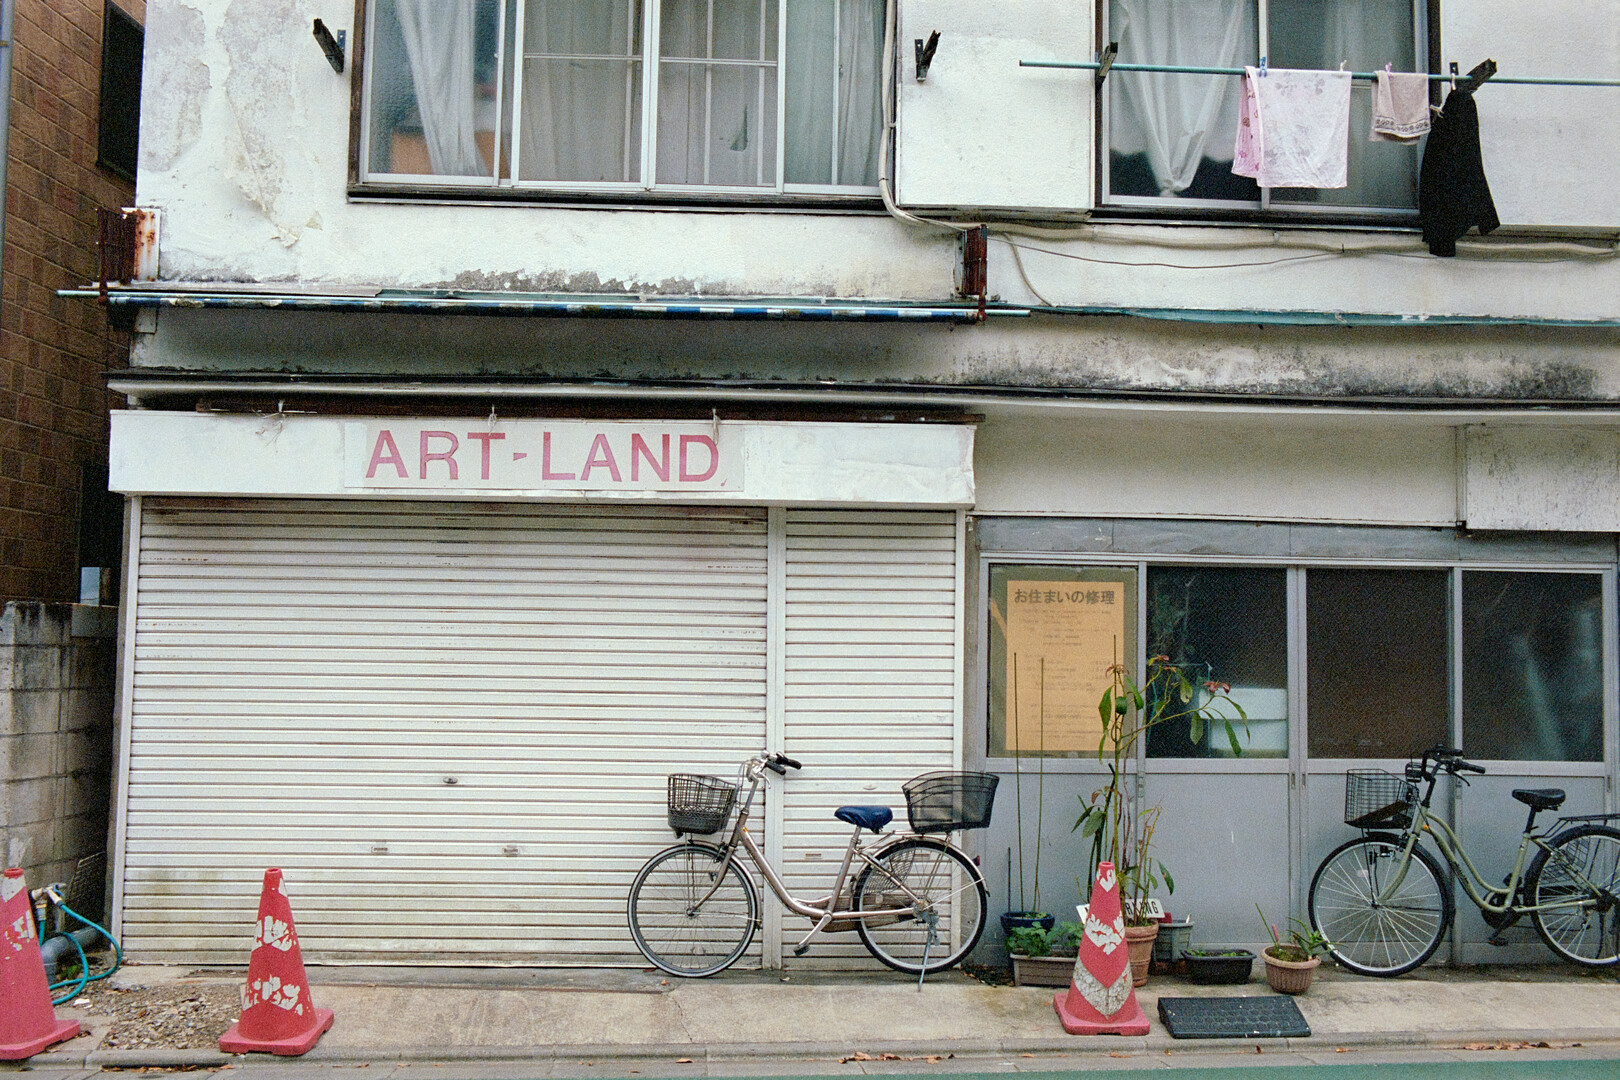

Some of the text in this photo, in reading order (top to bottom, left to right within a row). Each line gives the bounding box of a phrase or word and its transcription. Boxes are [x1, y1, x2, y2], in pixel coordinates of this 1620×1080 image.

[365, 429, 720, 483] ART-LAND
[1014, 588, 1115, 605] お住まいの修理
